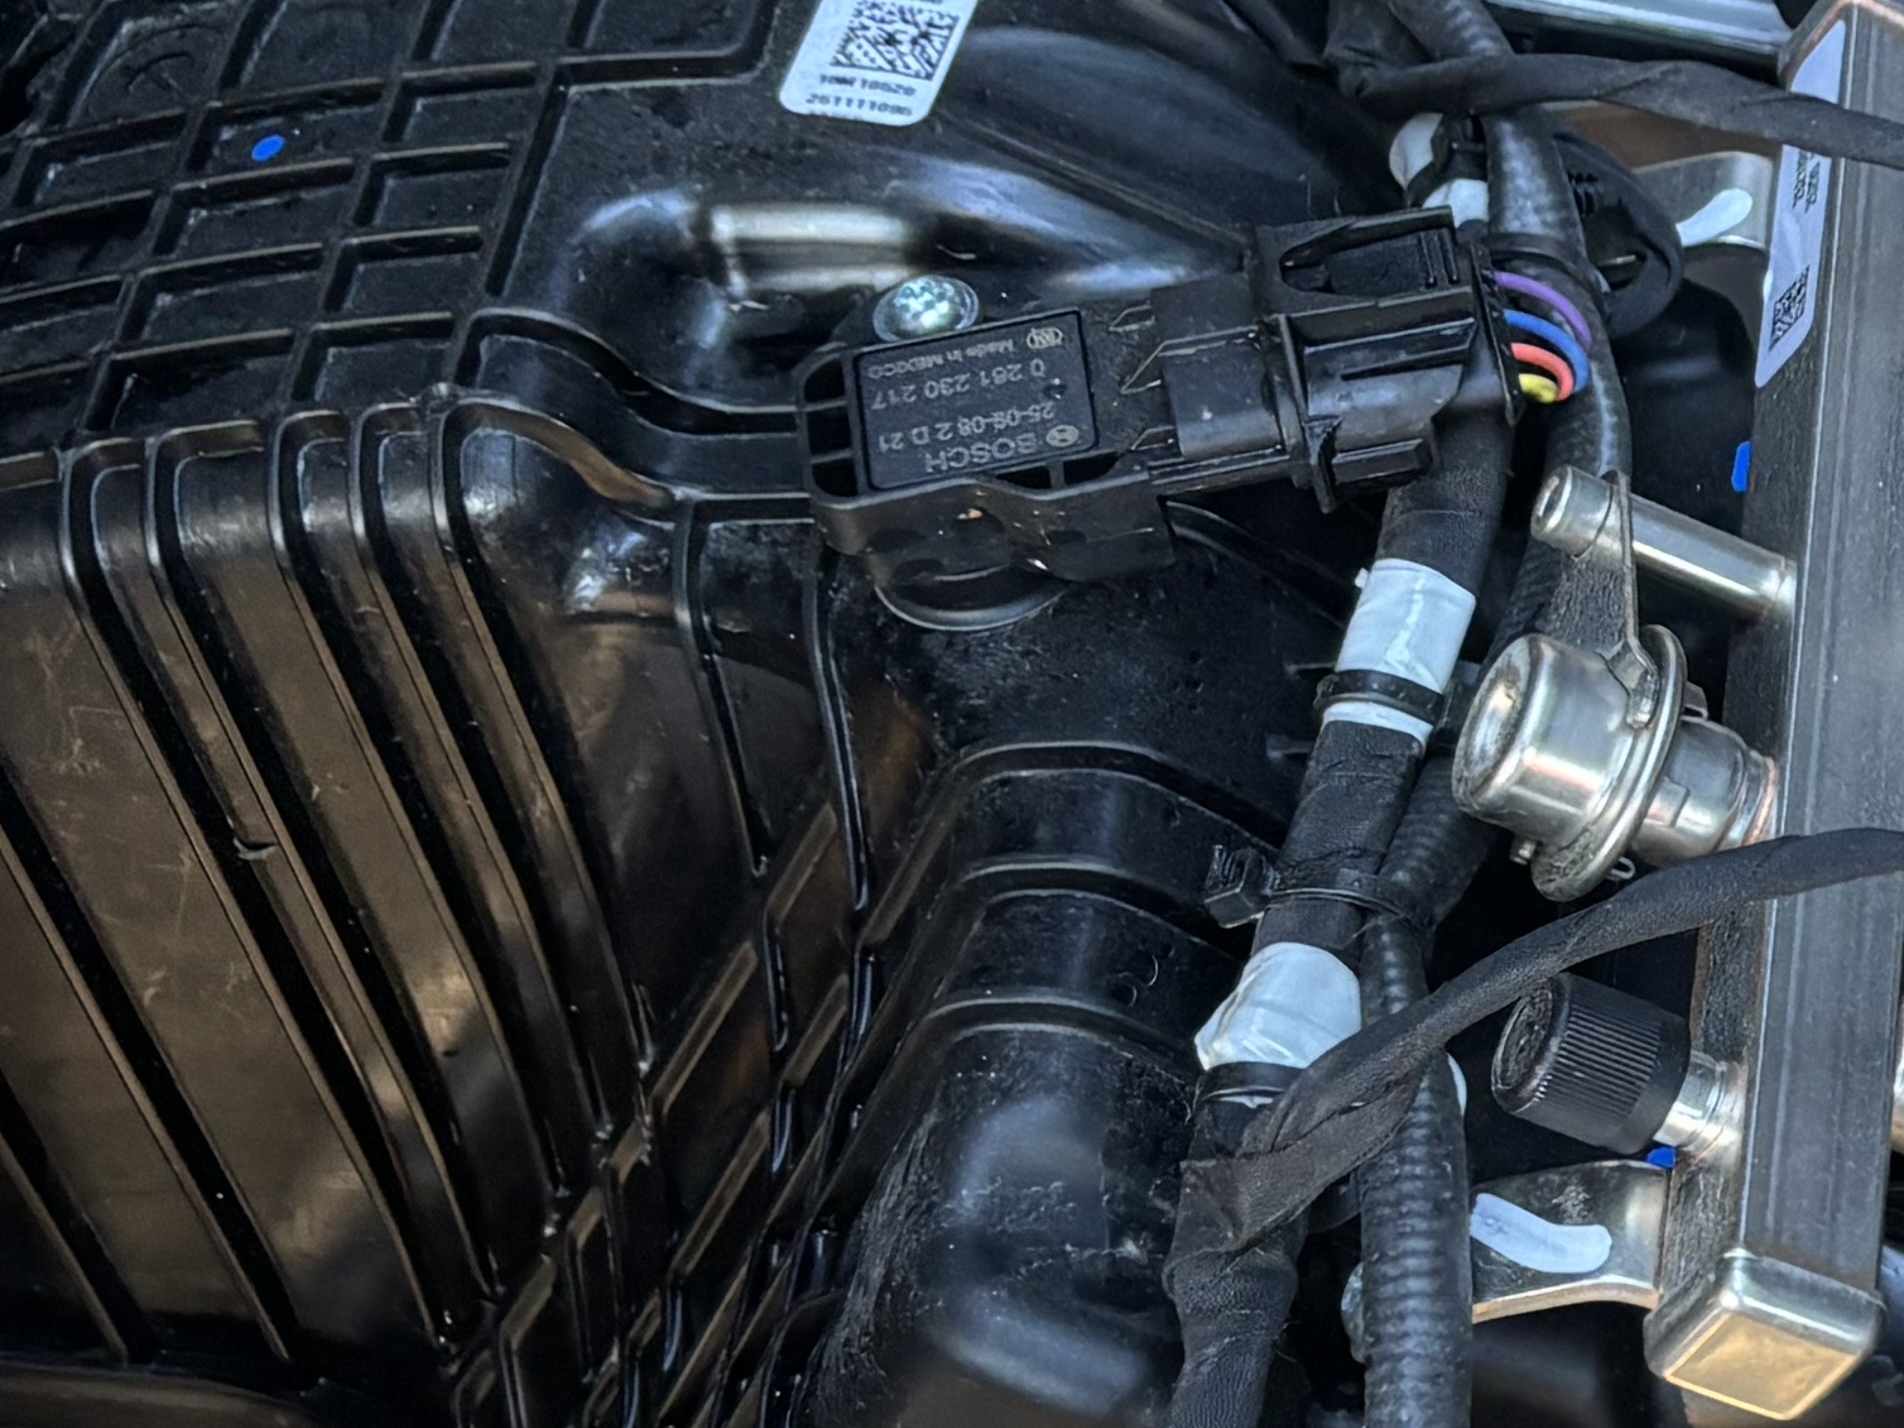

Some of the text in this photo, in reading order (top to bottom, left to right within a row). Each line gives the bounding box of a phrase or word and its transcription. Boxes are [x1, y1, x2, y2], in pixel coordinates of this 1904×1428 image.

[965, 339, 1014, 355] Made
[1030, 358, 1045, 377] 0
[924, 372, 970, 398] 230
[871, 384, 915, 409] 217
[910, 425, 928, 443] D
[934, 422, 953, 439] 2
[878, 431, 902, 452] 21
[924, 433, 1037, 472] BOSCH
